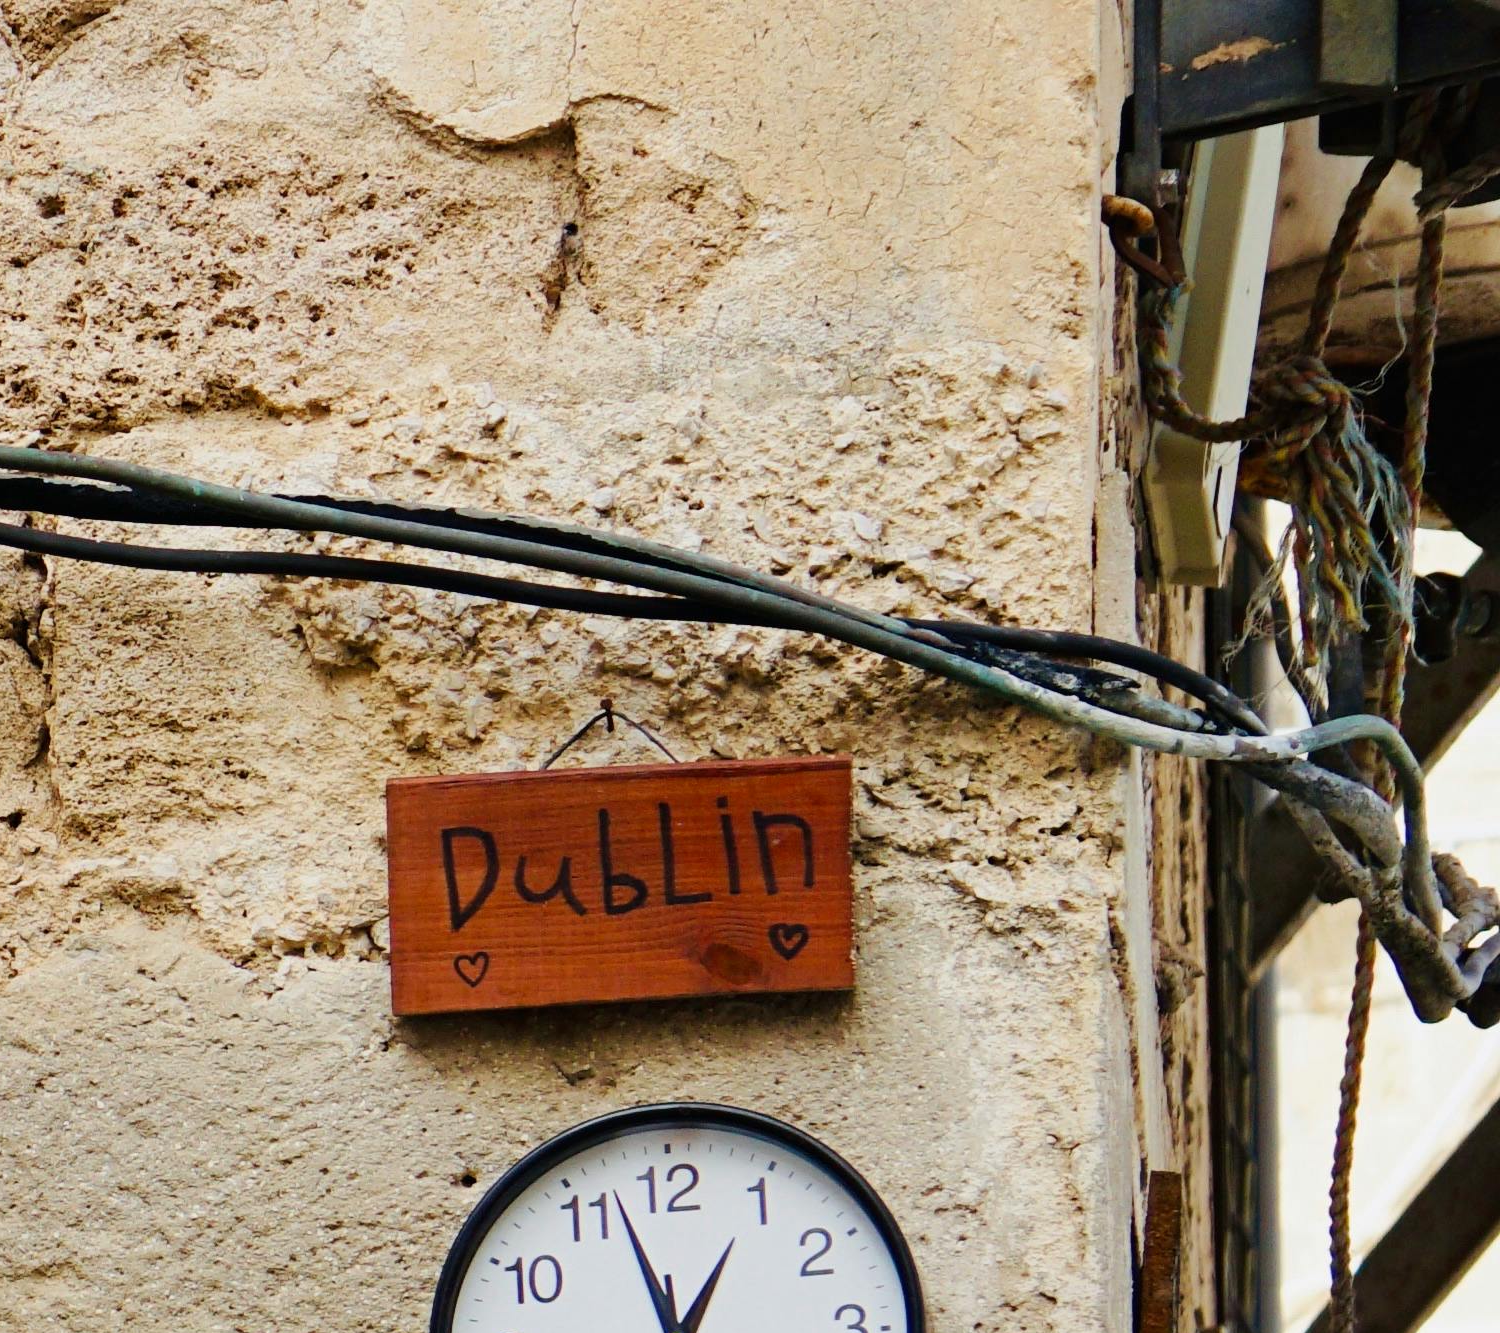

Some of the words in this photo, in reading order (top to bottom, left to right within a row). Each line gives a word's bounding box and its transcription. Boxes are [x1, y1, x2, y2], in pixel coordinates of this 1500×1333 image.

[636, 1162, 701, 1215] 12
[747, 1178, 769, 1226] 1
[560, 1191, 611, 1241] 11
[798, 1227, 834, 1278] 2
[504, 1254, 564, 1305] 10
